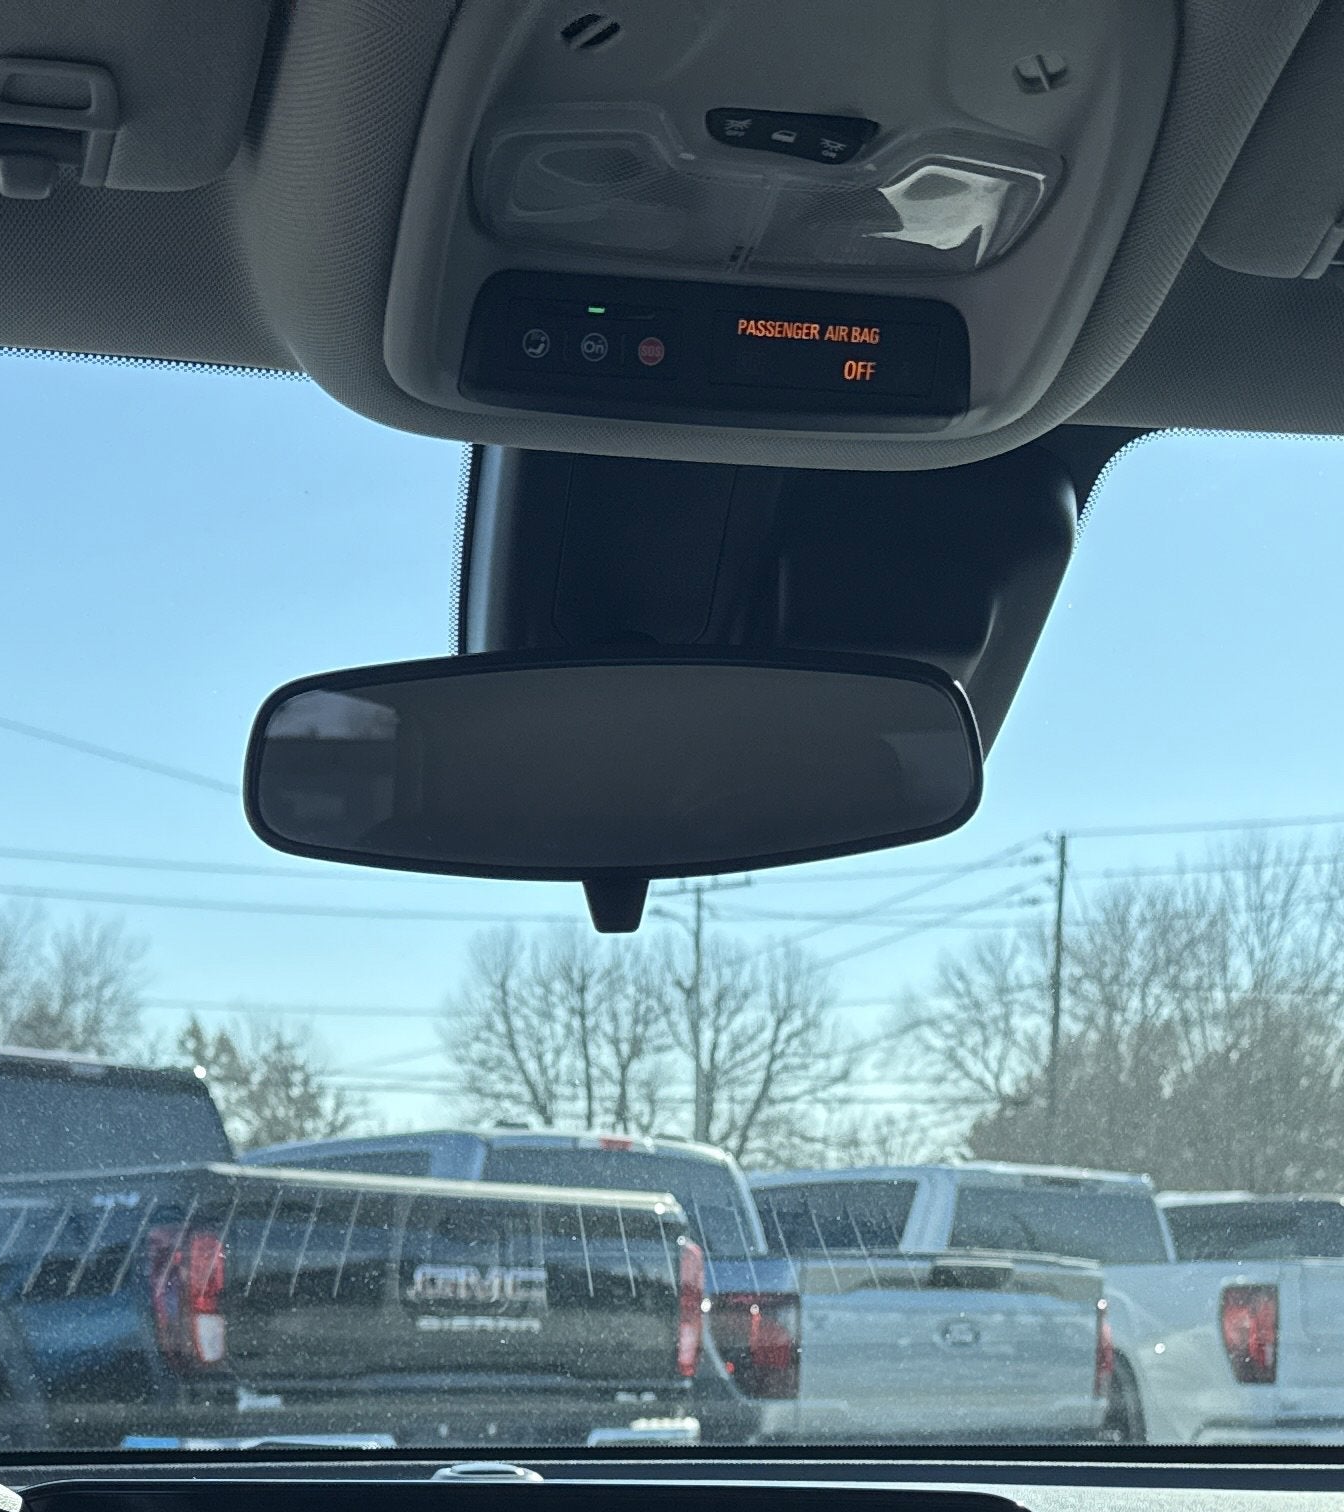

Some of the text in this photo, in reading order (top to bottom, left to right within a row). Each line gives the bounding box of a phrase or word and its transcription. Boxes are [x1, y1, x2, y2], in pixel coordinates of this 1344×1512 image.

[737, 319, 881, 345] PASSENGER AIR BAG
[640, 345, 661, 357] SOS
[843, 359, 877, 381] OFF
[408, 1264, 547, 1300] GMC
